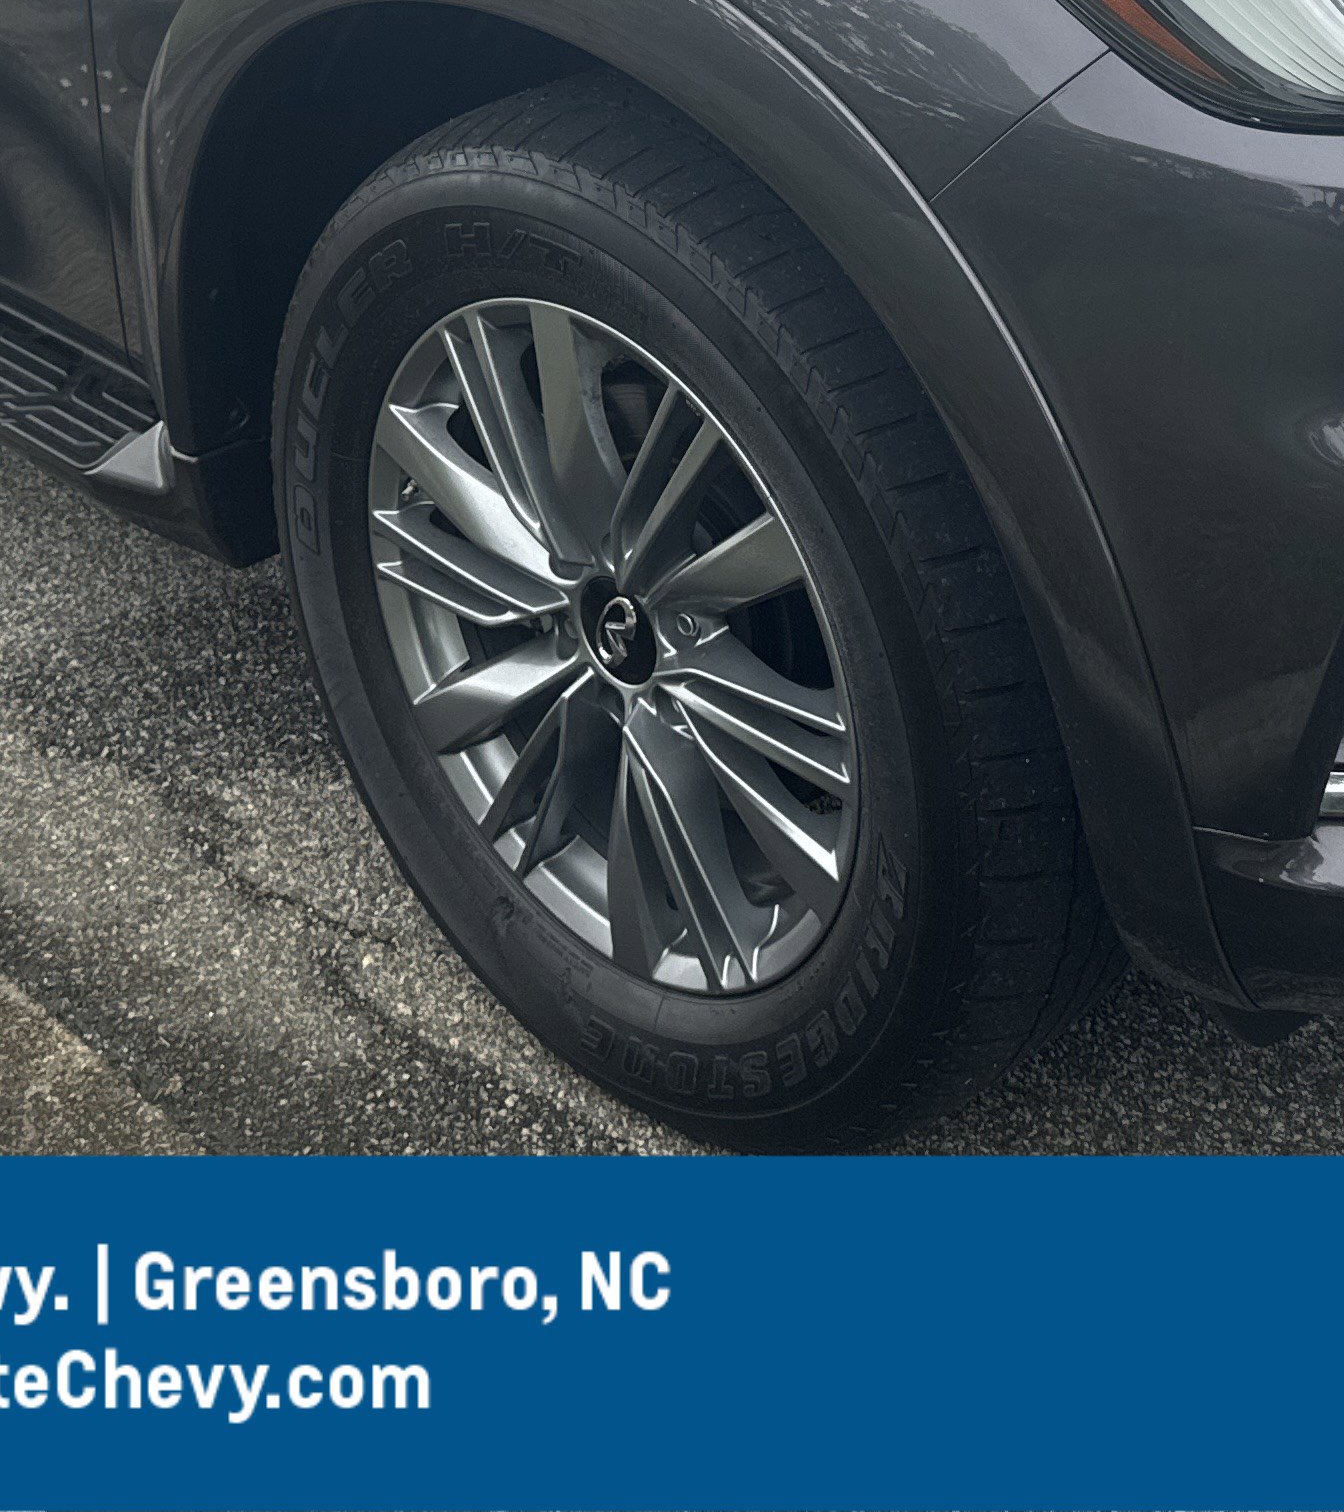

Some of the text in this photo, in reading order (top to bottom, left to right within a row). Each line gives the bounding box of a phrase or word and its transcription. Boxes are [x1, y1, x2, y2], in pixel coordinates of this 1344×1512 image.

[292, 221, 583, 555] DUELER H/T
[579, 831, 910, 1101] BRIDGESTONE
